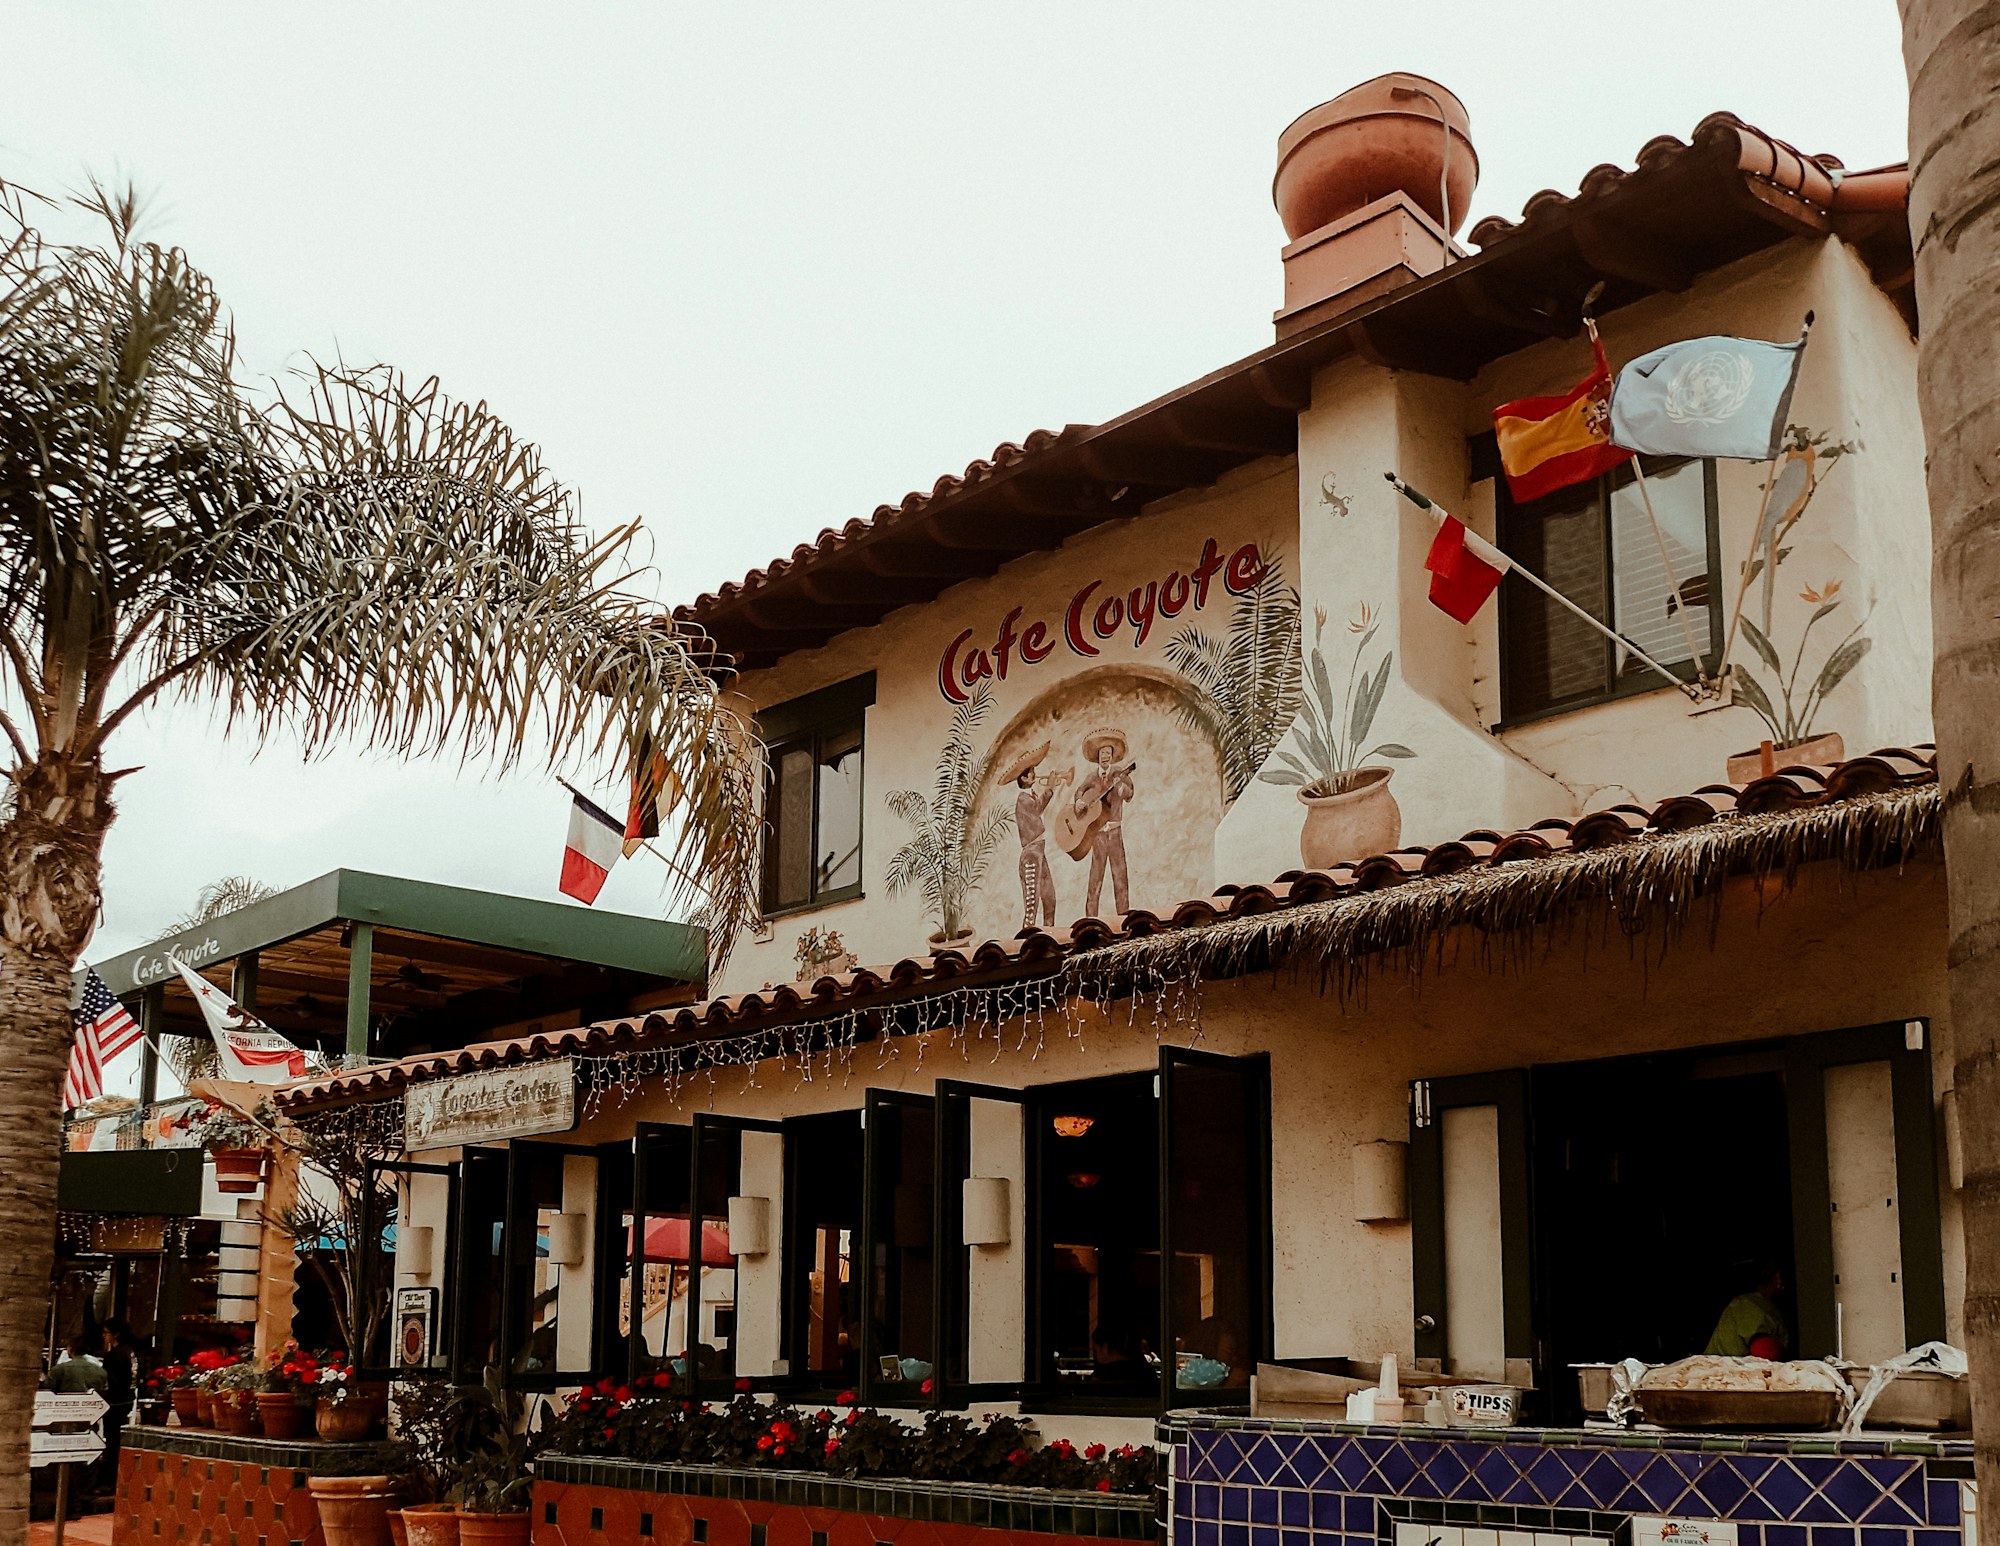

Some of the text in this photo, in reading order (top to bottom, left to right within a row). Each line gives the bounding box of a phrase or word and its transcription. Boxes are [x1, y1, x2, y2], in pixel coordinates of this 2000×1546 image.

[939, 537, 1270, 705] Cafe Coyote
[133, 937, 220, 985] Cafe Coyote
